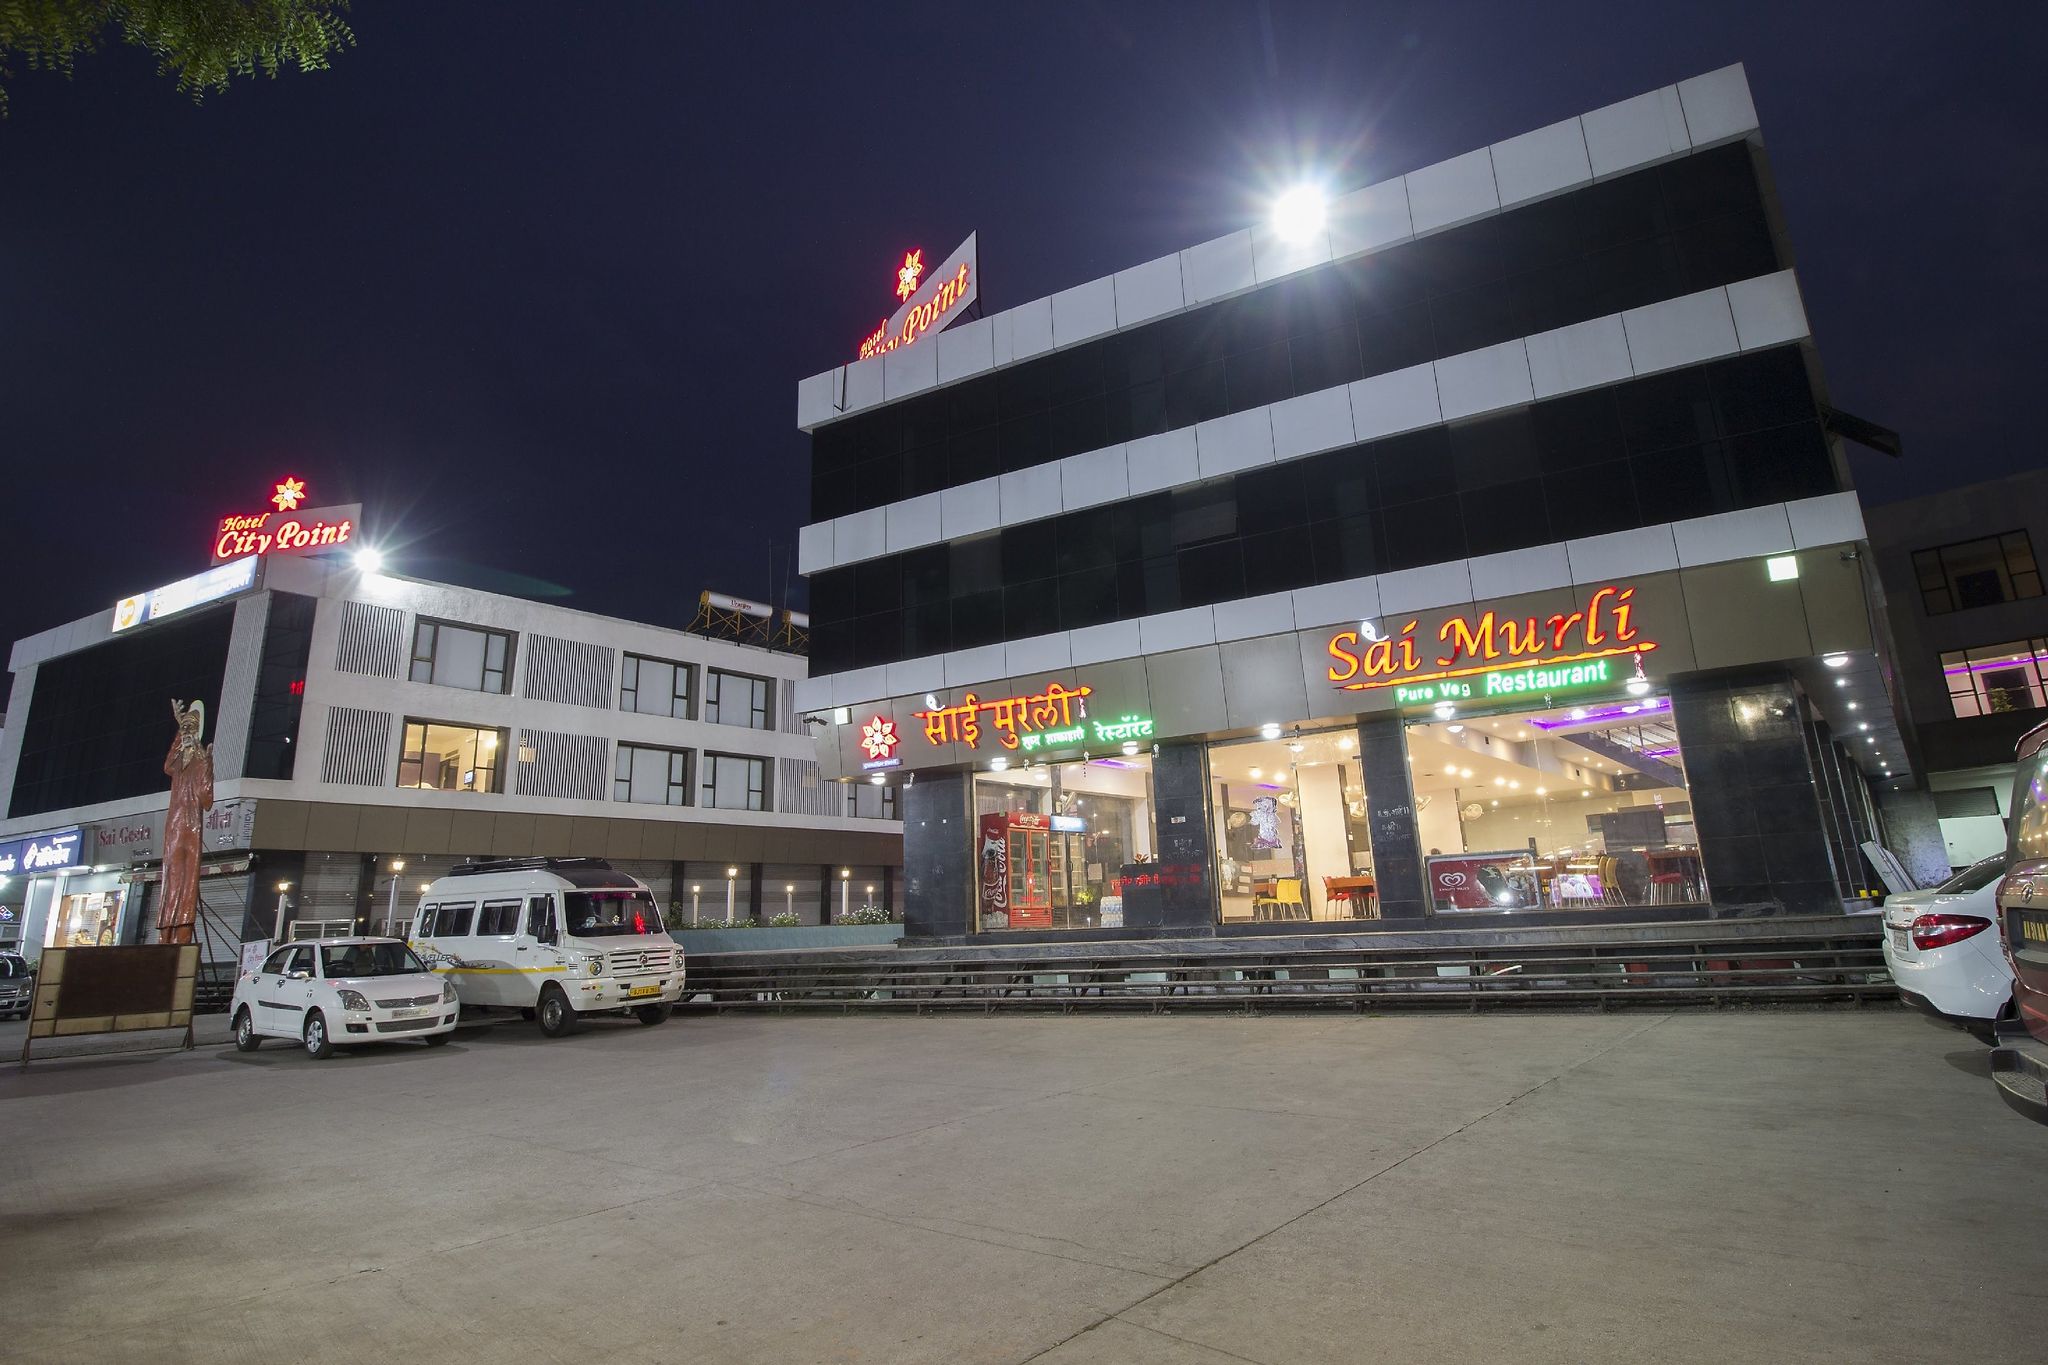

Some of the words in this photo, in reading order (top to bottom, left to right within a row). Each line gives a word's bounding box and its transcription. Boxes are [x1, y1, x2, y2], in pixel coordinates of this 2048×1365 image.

[903, 263, 968, 345] Point
[859, 318, 887, 360] Hotel
[217, 531, 271, 558] City
[276, 520, 351, 550] Point
[221, 513, 270, 532] Hotel
[1327, 619, 1421, 682] Sai
[1437, 586, 1638, 667] Murli
[1397, 685, 1434, 703] Pure
[1439, 682, 1471, 698] Veg
[1486, 660, 1608, 695] Restaurant
[922, 694, 982, 748] साई
[992, 684, 1078, 751] मुरली
[98, 829, 116, 846] Sai
[415, 952, 452, 963] RAVELLER
